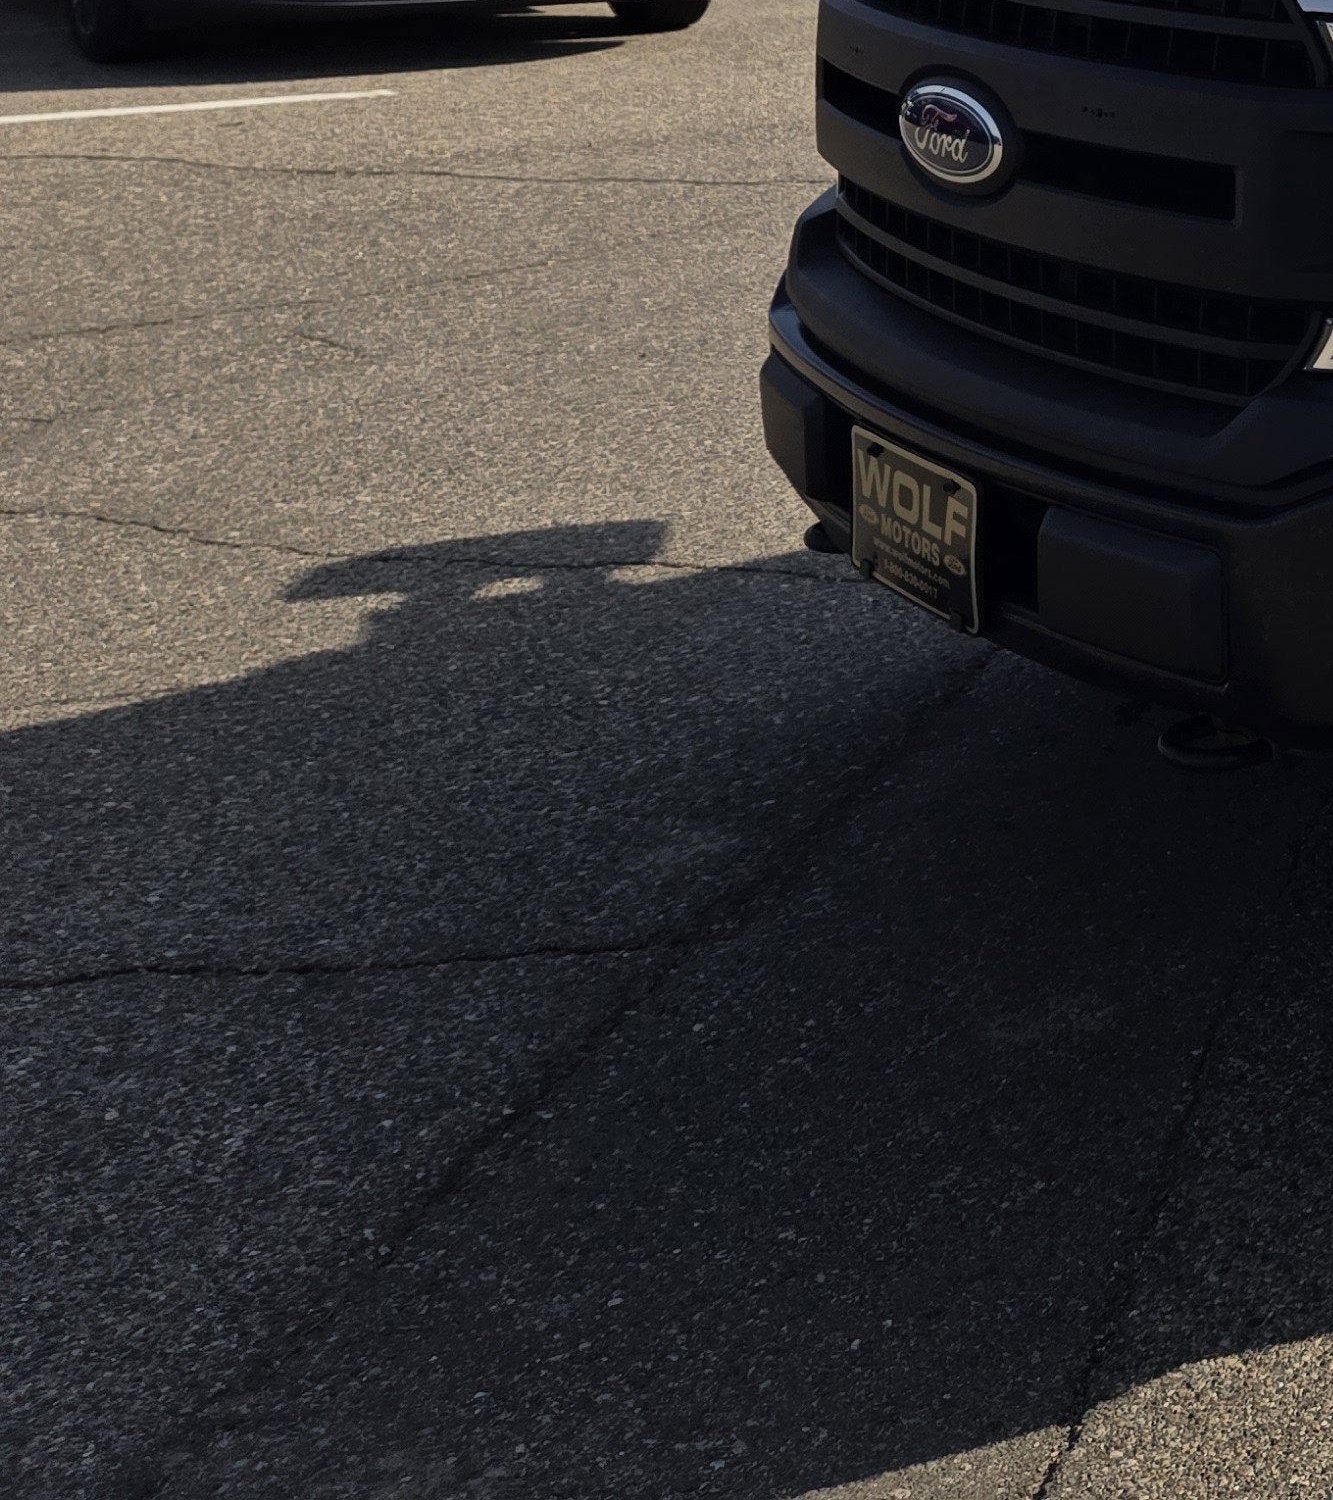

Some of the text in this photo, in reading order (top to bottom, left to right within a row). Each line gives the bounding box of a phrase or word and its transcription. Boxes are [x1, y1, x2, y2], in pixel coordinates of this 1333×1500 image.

[914, 104, 971, 164] Ford
[857, 448, 968, 546] WOLF
[880, 513, 940, 567] MOTORS
